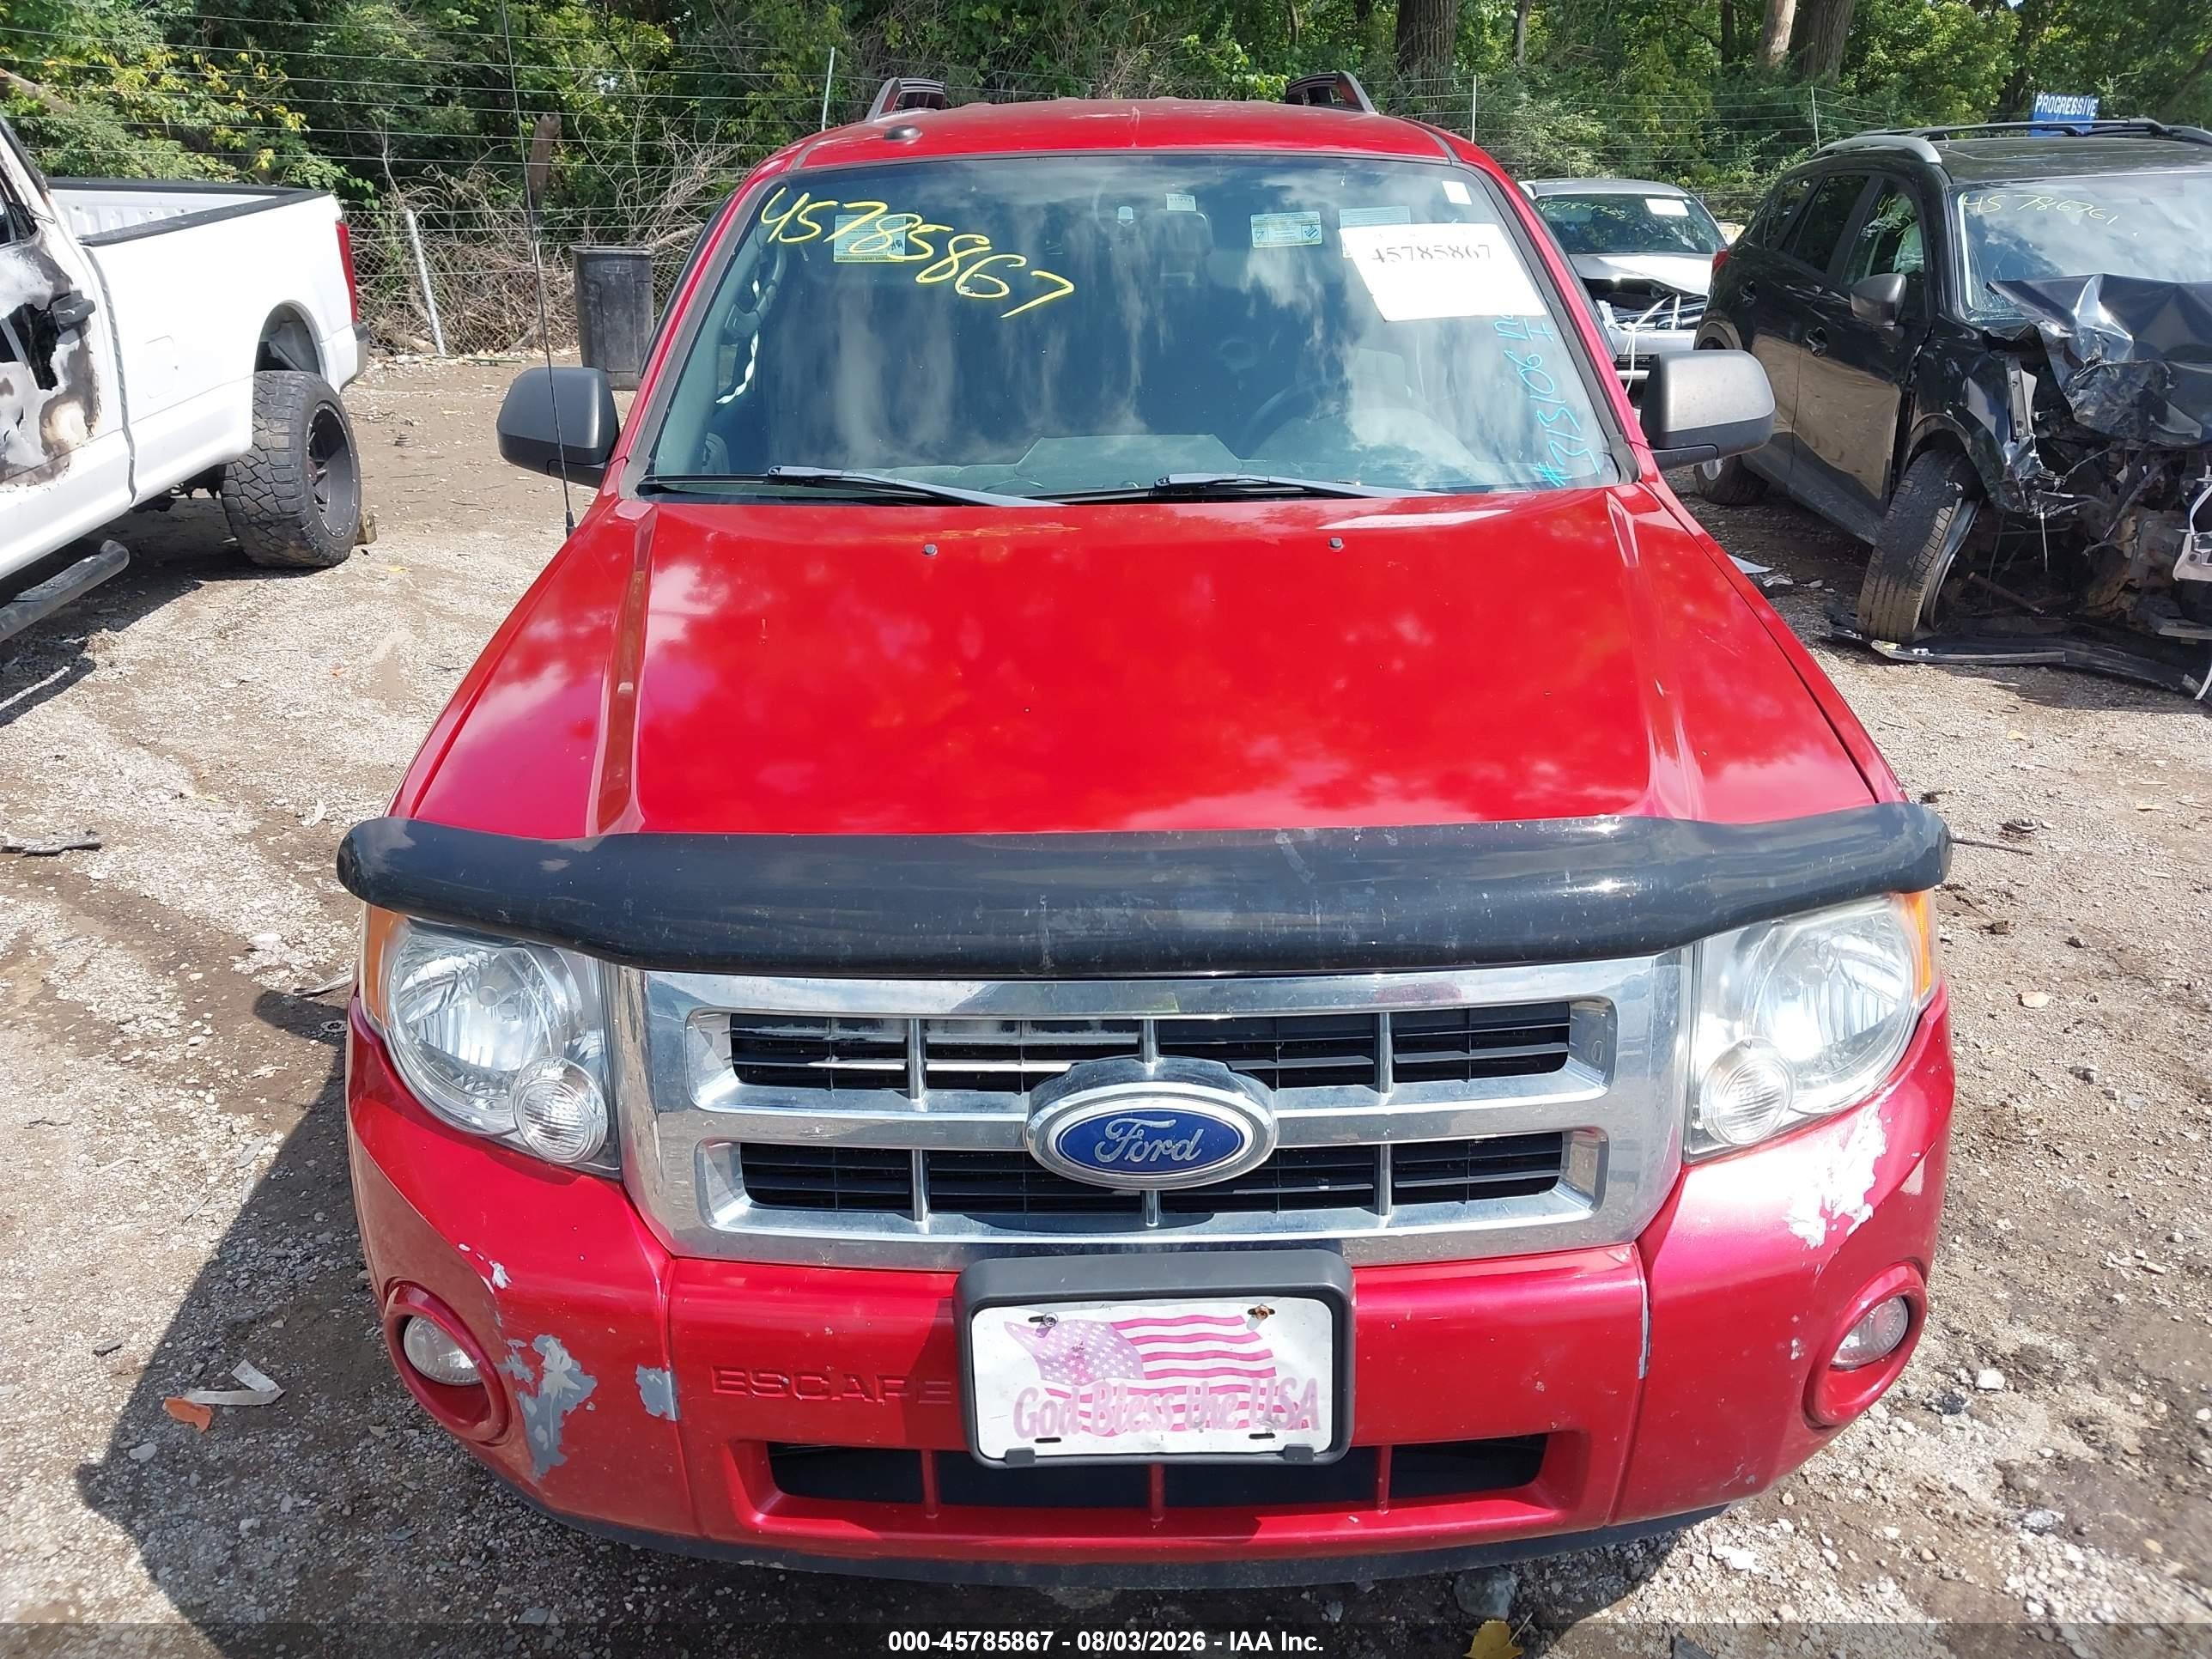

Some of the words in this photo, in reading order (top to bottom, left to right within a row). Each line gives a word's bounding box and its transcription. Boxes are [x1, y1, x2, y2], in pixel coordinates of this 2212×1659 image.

[2035, 94, 2100, 117] PROGRESSIVE
[761, 186, 1075, 319] 45785867
[1095, 1117, 1204, 1163] Ford
[711, 1366, 952, 1406] ESCAPE
[1012, 1386, 1084, 1439] God
[1091, 1380, 1176, 1437] Bless
[1184, 1380, 1241, 1433] the
[1249, 1376, 1321, 1432] USA
